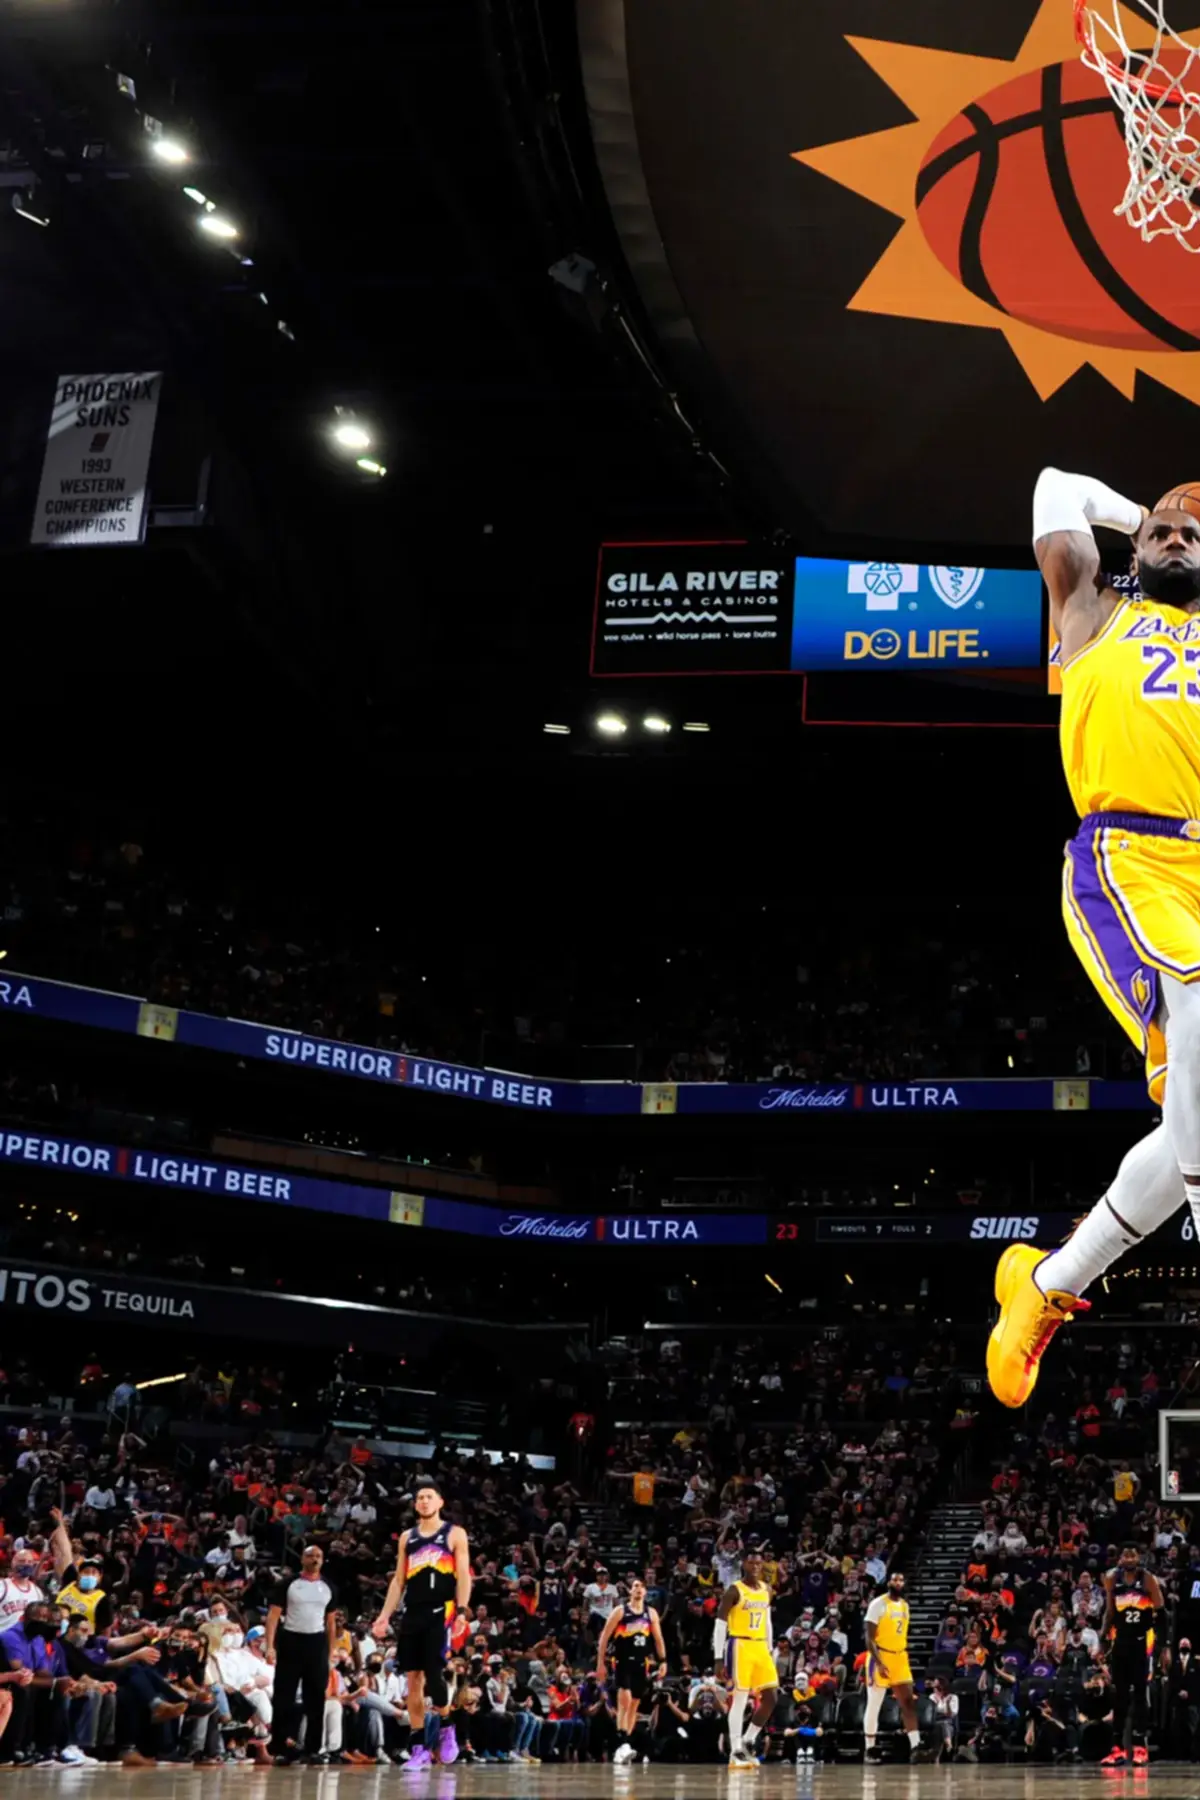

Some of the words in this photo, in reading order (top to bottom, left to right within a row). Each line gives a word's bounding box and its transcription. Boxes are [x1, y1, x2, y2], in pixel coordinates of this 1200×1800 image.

[61, 380, 153, 402] PHOENIX
[76, 405, 131, 428] SUNS
[82, 458, 112, 473] 1993
[60, 478, 125, 494] WESTERN
[45, 497, 134, 514] CONFERENCE
[46, 518, 126, 534] CHAMPIONS
[607, 572, 679, 592] GILA
[686, 570, 779, 590] RIVER
[605, 598, 672, 607] HOTELS
[682, 598, 691, 606] &
[701, 596, 778, 606] CASINOS
[676, 631, 699, 640] horse
[702, 632, 721, 642] pass
[908, 629, 989, 659] LIFE.
[265, 1035, 392, 1078] SUPERIOR
[413, 1063, 485, 1096] LIGHT
[491, 1079, 553, 1107] BEER
[759, 1087, 848, 1110] Michelob
[871, 1087, 958, 1106] ULTRA
[134, 1155, 217, 1188] LIGHT
[224, 1169, 291, 1200] BEER
[499, 1214, 590, 1239] Michelob
[612, 1218, 698, 1240] ULTRA
[776, 1223, 798, 1240] 23
[102, 1290, 194, 1318] TEQUILA
[749, 1612, 762, 1629] 17
[1125, 1610, 1141, 1624] 22
